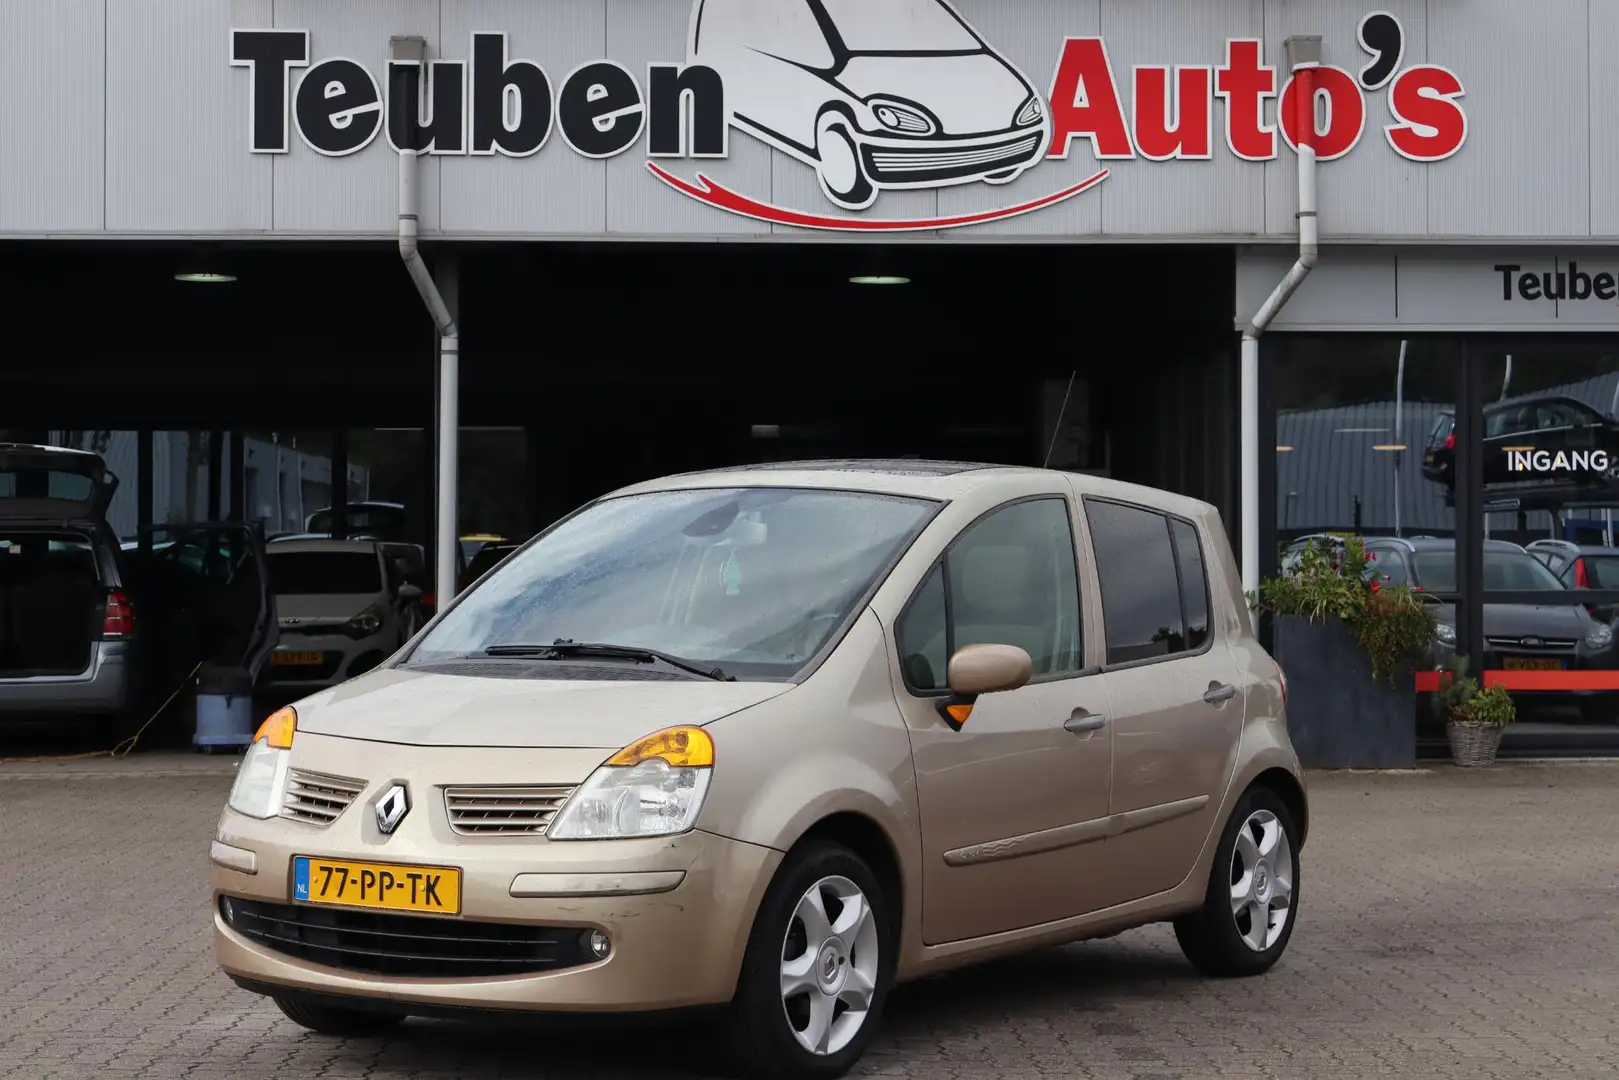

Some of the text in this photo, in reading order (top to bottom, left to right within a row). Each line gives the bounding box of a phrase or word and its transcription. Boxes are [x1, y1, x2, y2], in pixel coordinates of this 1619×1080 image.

[231, 12, 1465, 160] Teuben Auto's
[1494, 261, 1619, 301] Teube
[1507, 450, 1609, 472] INGANG
[297, 883, 308, 894] NL
[319, 865, 443, 906] 77-PP-TK
